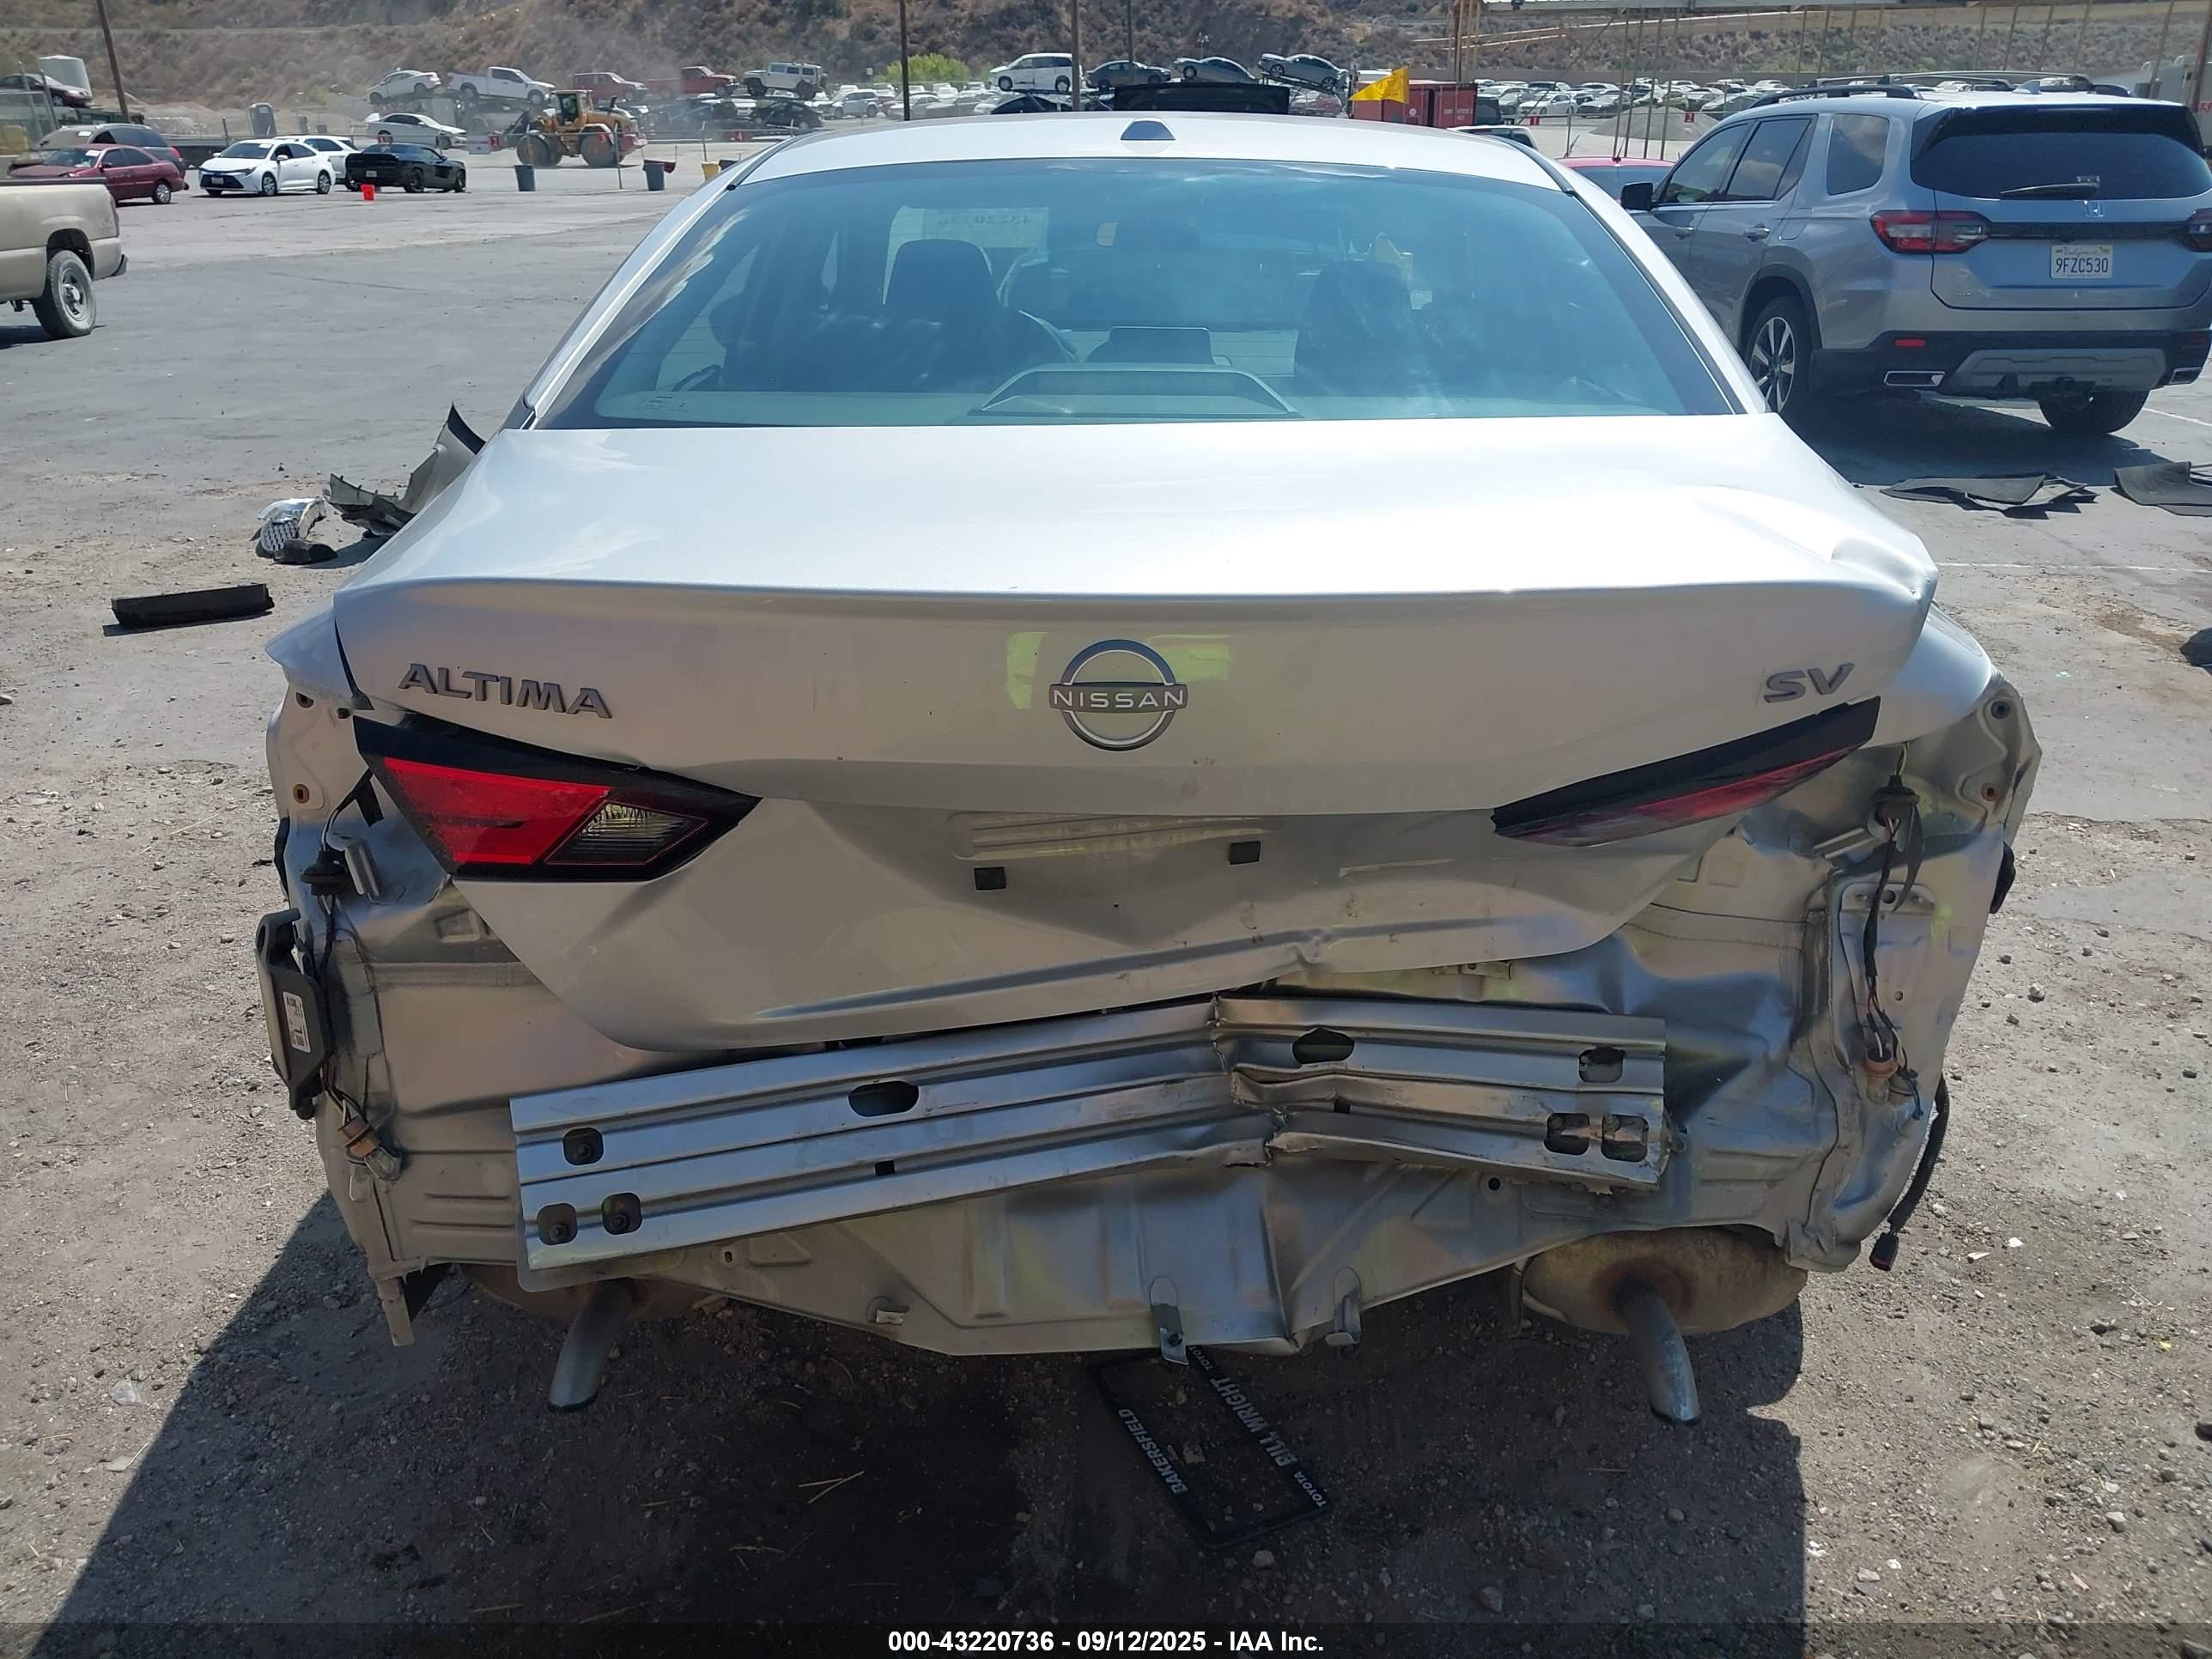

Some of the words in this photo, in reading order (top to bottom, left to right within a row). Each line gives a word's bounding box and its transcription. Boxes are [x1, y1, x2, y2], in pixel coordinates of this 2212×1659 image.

[2055, 257, 2109, 273] 9FZC530
[398, 663, 612, 720] ALTIMA
[1053, 690, 1184, 708] NISSAN
[1764, 662, 1855, 703] SV
[1188, 1346, 1213, 1371] TOYOT
[1209, 1377, 1270, 1433] WRIGHT
[1118, 1408, 1188, 1494] BAKERSFIELD
[1258, 1431, 1298, 1467] BILL
[1293, 1470, 1328, 1508] TOYOTA
